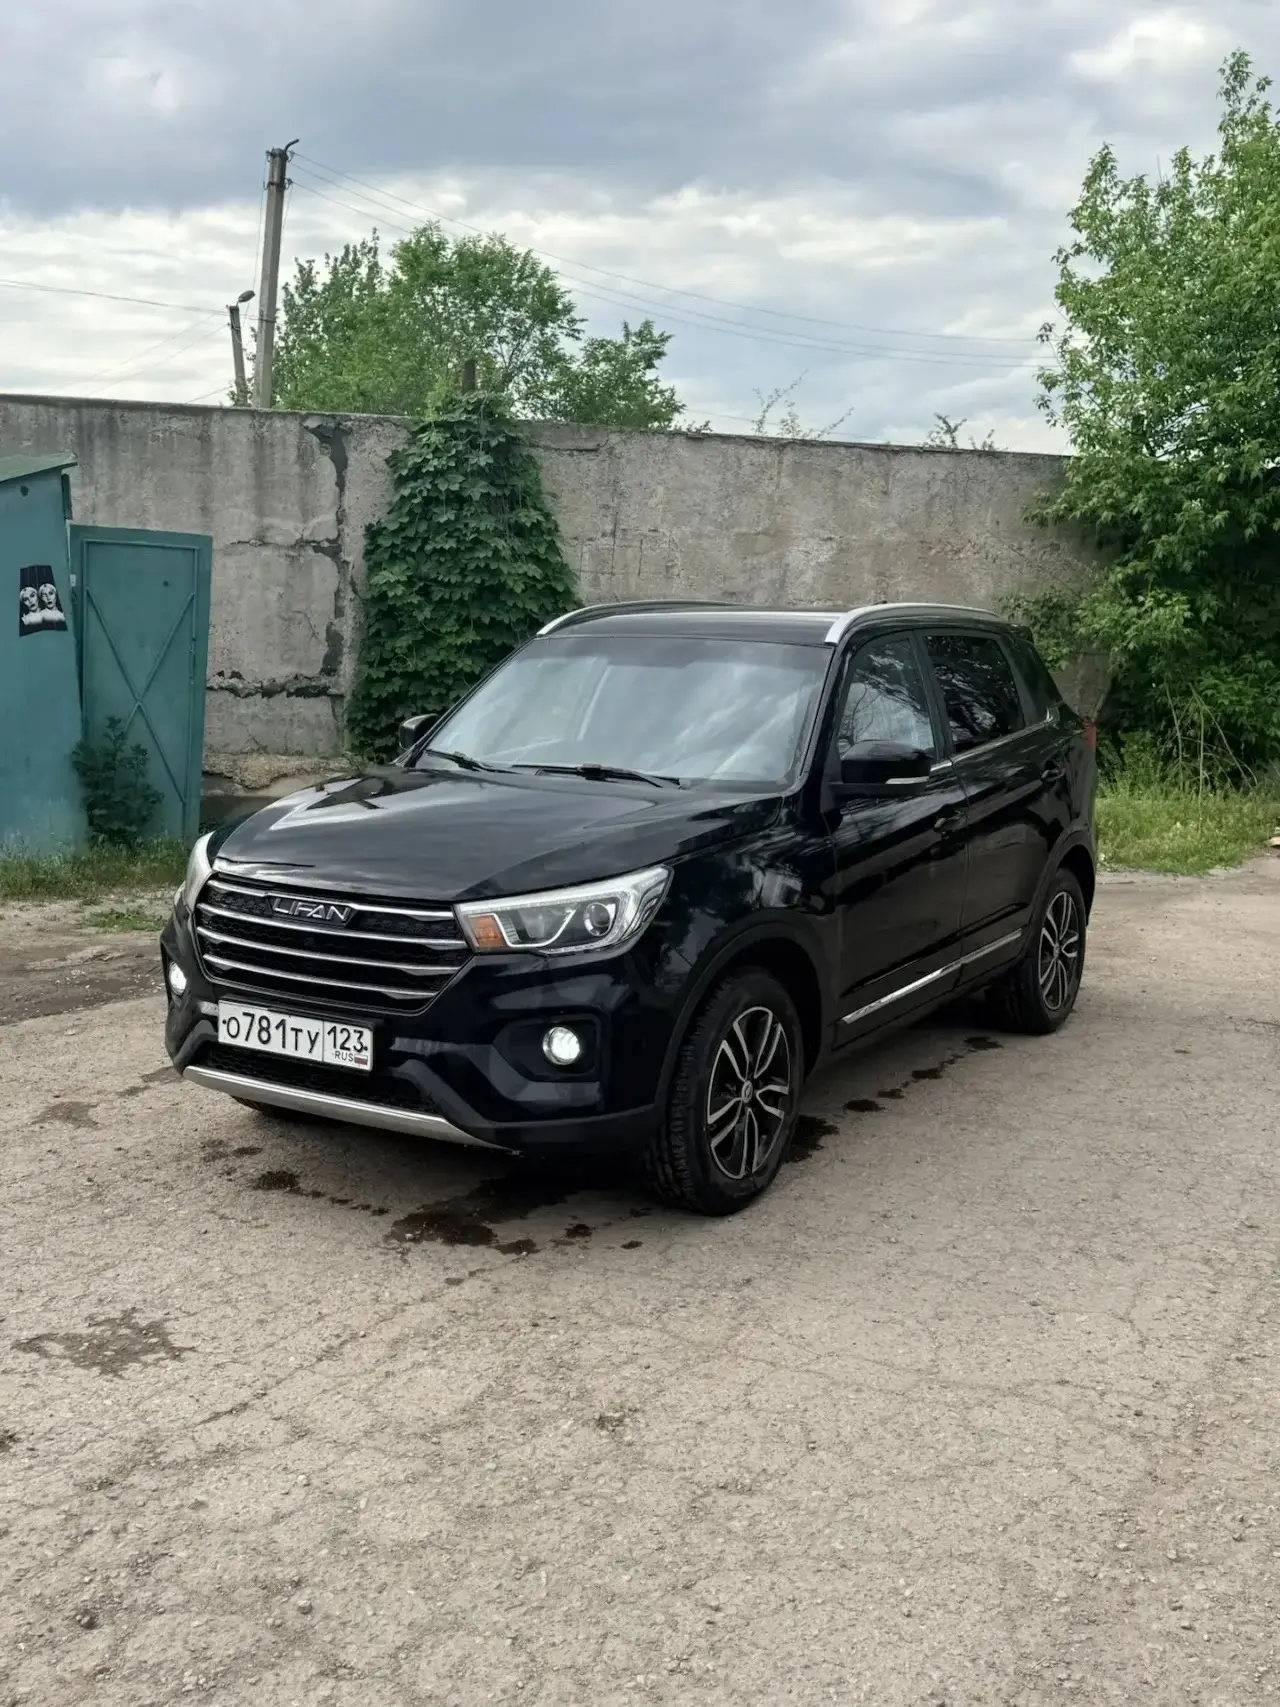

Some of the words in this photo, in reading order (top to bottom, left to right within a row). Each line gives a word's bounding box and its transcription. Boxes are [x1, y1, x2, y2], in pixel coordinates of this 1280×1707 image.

[272, 897, 352, 921] LIFAN
[327, 1025, 364, 1053] 123
[334, 1051, 354, 1063] RUS
